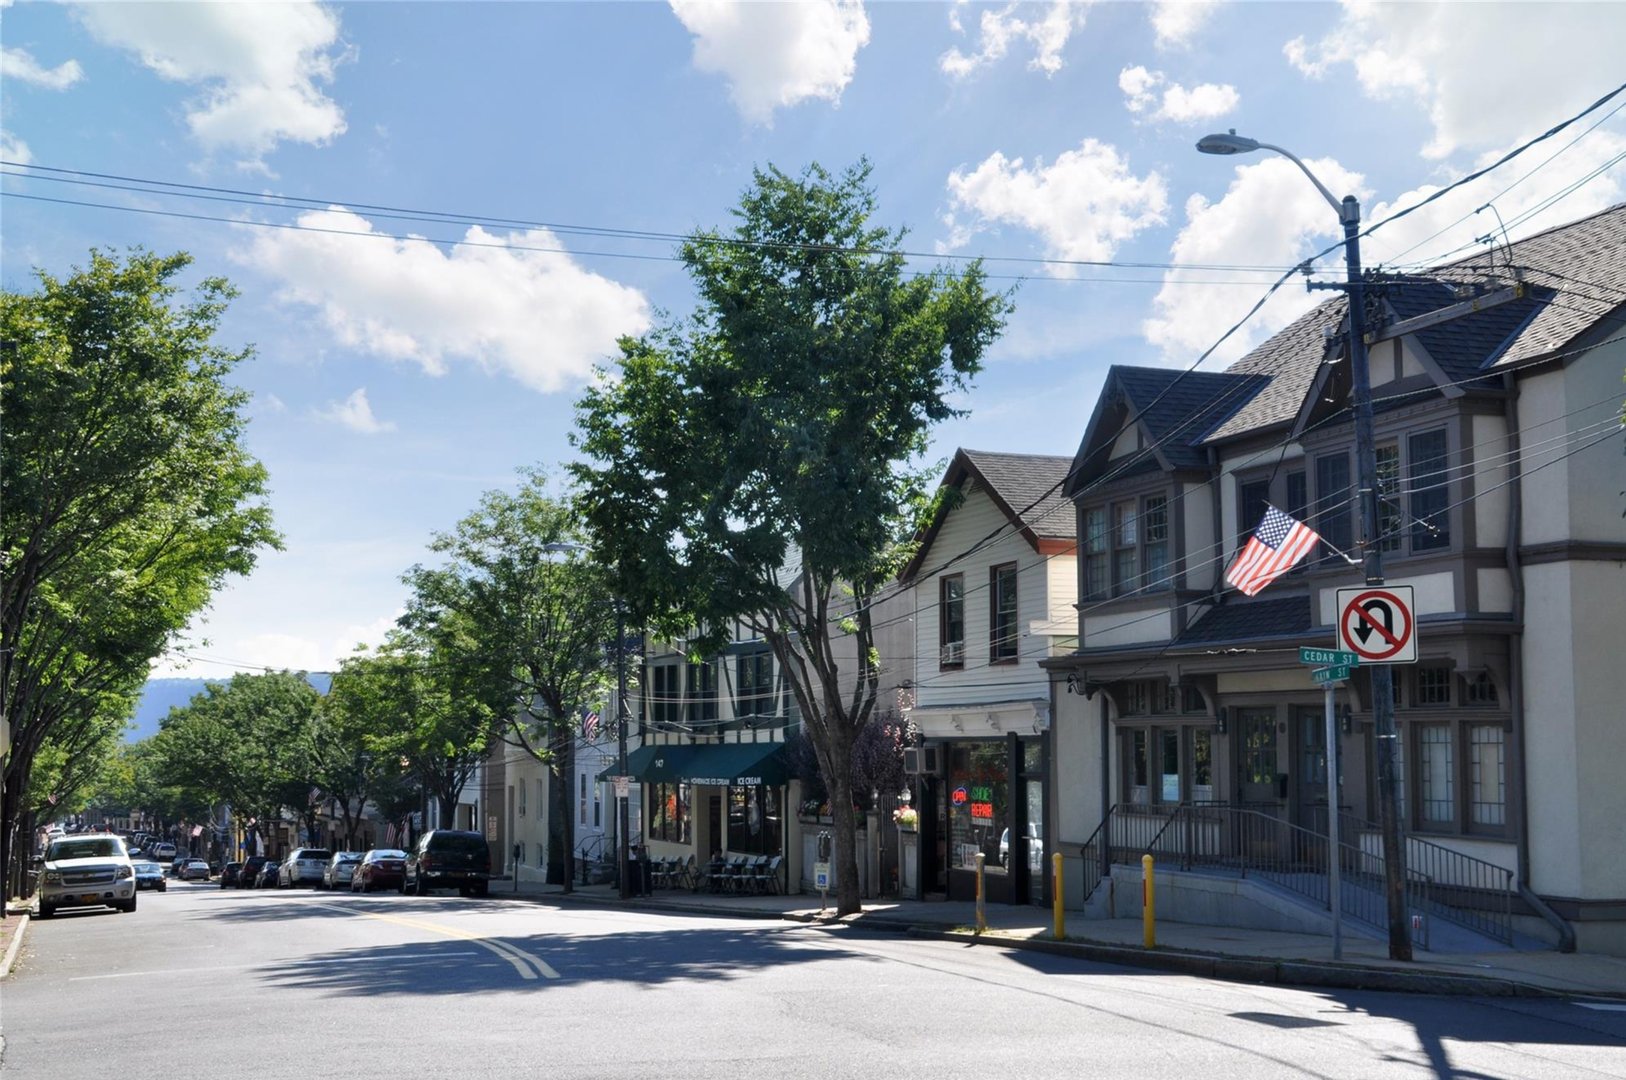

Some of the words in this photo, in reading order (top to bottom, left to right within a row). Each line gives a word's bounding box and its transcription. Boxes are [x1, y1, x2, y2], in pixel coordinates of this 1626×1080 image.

[1304, 651, 1335, 663] CEDAR
[1342, 654, 1353, 665] ST
[1338, 667, 1346, 677] ST
[971, 803, 993, 818] REPAIR
